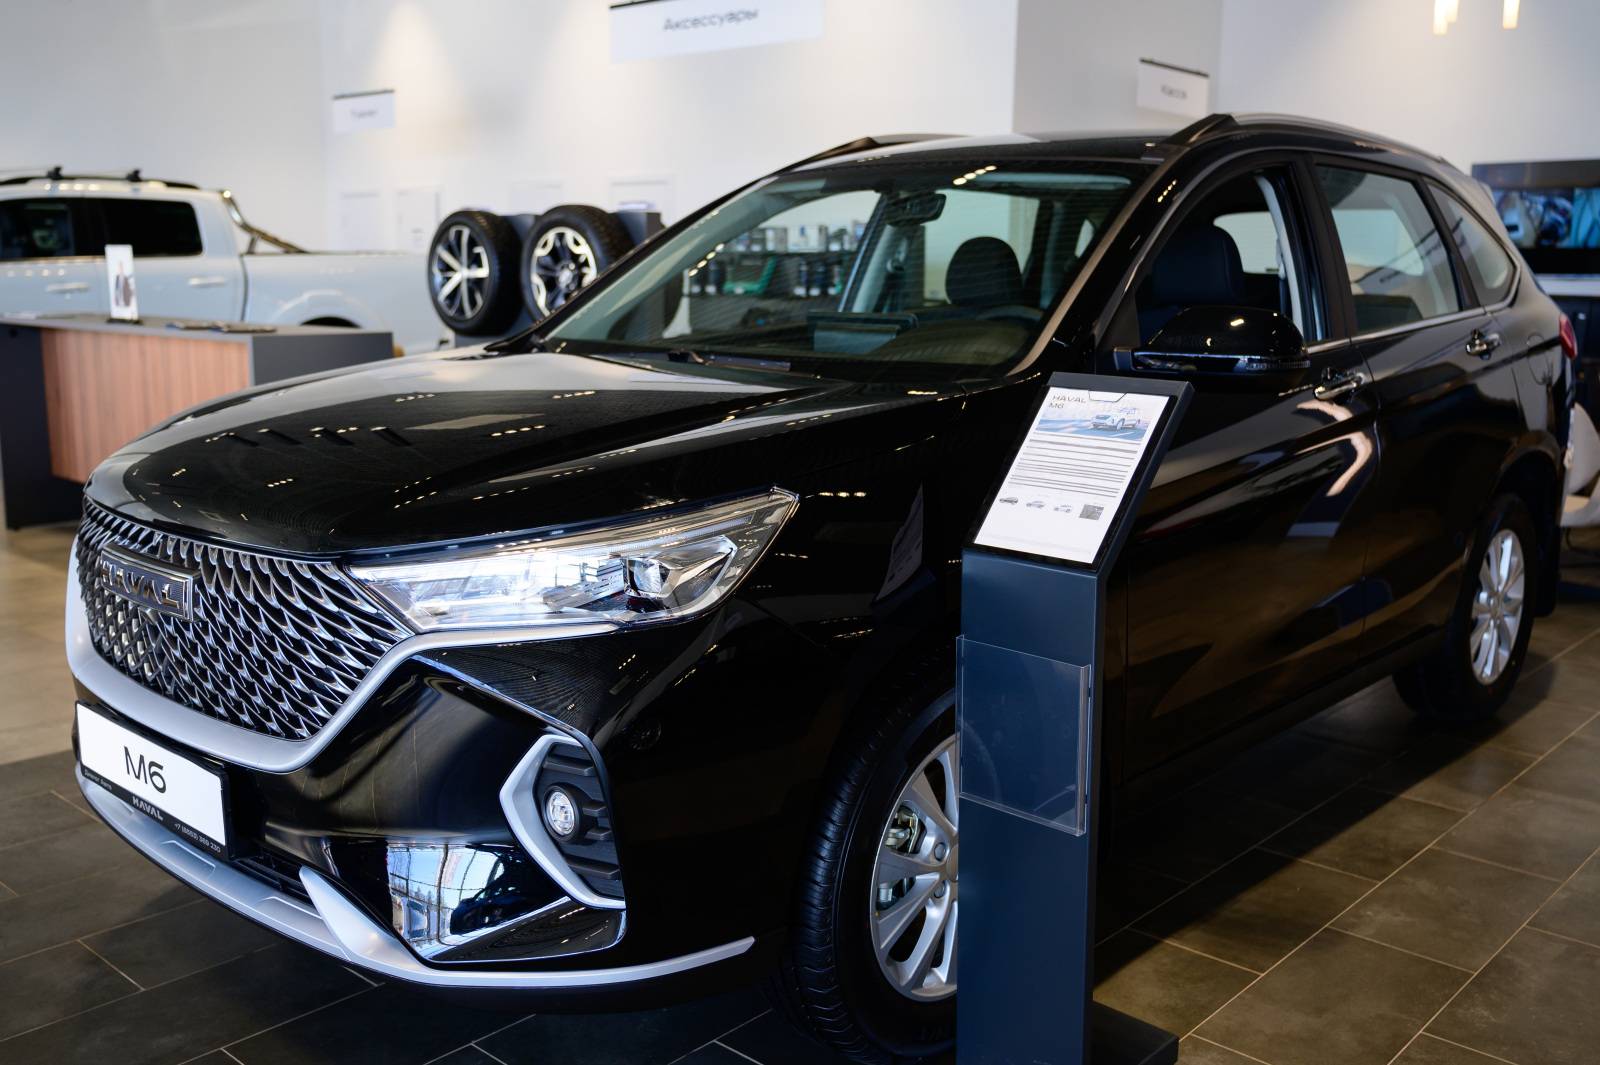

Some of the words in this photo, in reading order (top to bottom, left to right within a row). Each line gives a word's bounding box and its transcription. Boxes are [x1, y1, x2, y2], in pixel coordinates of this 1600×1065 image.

[663, 9, 759, 31] Аксессуары
[100, 560, 180, 610] HAVAL
[123, 745, 167, 794] M6
[132, 796, 164, 821] HAVAL
